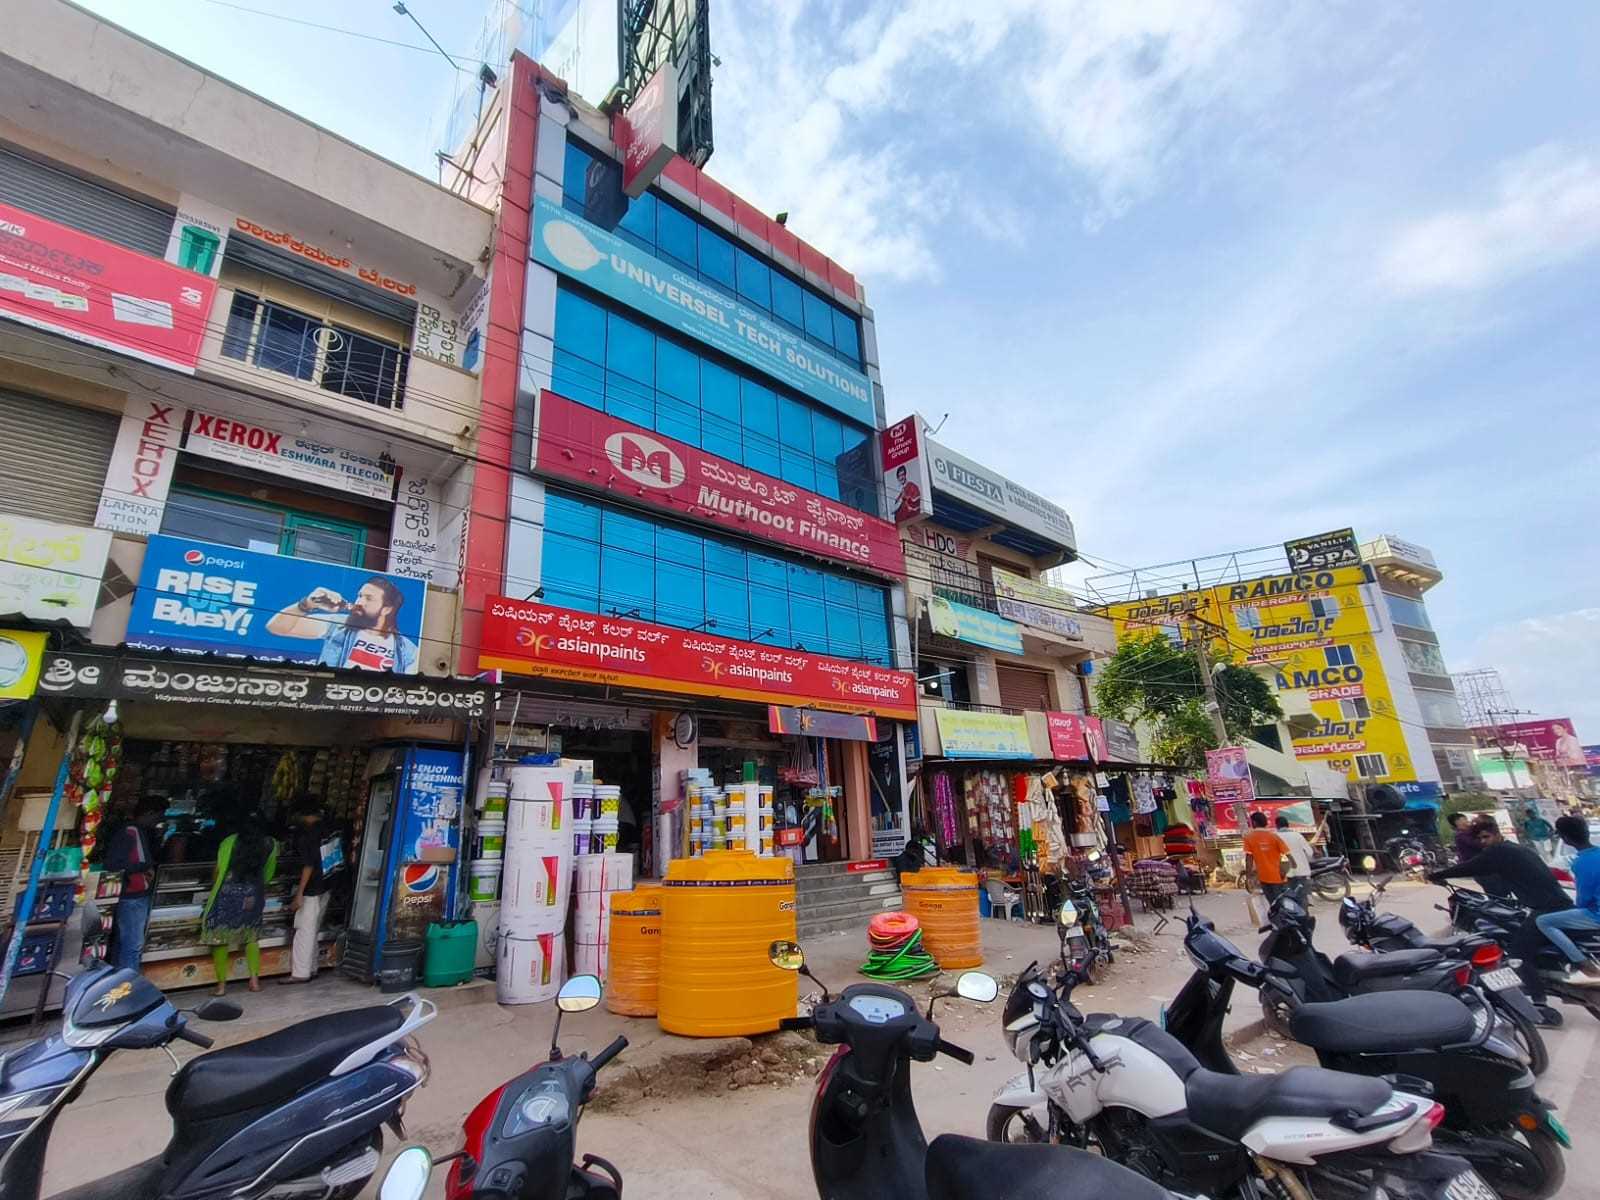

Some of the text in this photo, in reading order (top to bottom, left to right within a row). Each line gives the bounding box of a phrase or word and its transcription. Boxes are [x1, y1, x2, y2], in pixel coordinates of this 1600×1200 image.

[609, 253, 731, 329] UNIVERSEL
[735, 320, 782, 357] TECH
[785, 346, 869, 402] SOLUTIONS
[194, 412, 283, 454] XEROX
[131, 402, 174, 498] XEROX
[280, 448, 336, 470] ESHWARA
[952, 466, 1003, 503] FIESTA
[697, 485, 871, 559] Muthoot Finance
[205, 555, 245, 569] pepsi
[1311, 549, 1356, 567] SPA
[155, 568, 258, 606] RISE
[1229, 572, 1334, 601] RAMCO
[152, 598, 254, 635] BABY!
[557, 637, 646, 662] asianpaints
[122, 665, 309, 701] ಮಂಜುನಾಥ
[729, 663, 793, 685] asianpaints
[852, 682, 899, 700] asianpaints
[418, 764, 449, 774] ENJOY
